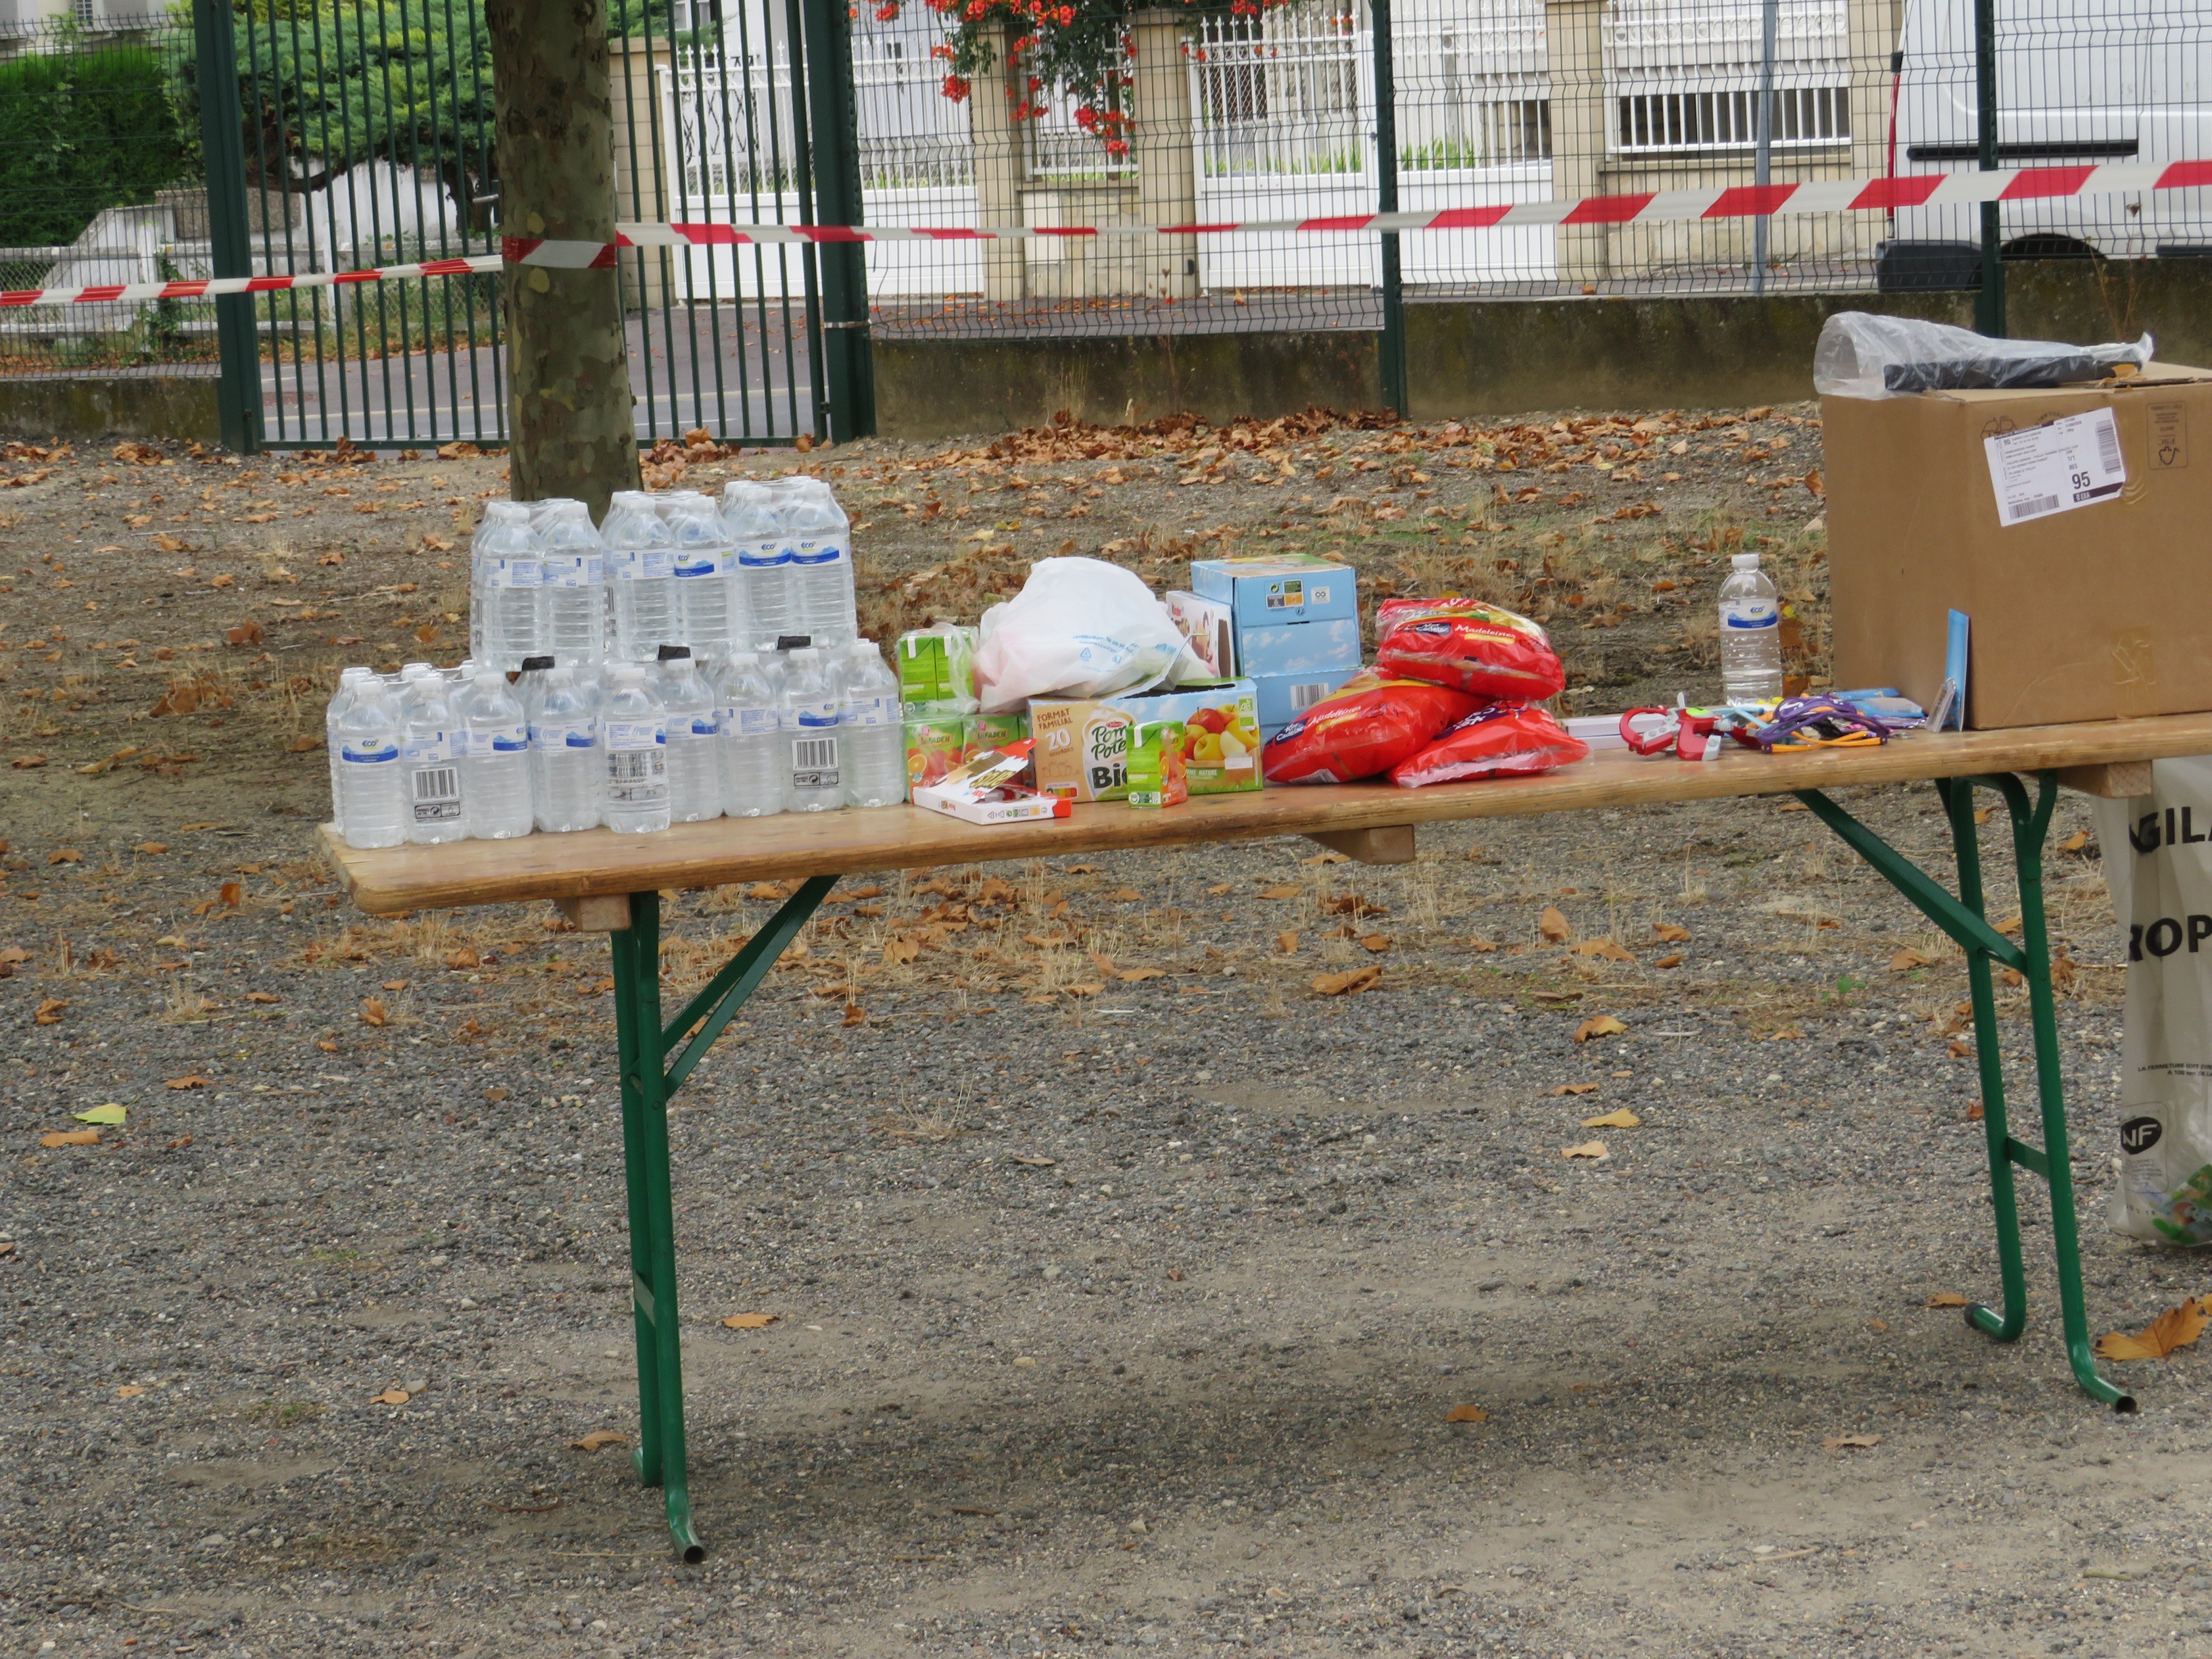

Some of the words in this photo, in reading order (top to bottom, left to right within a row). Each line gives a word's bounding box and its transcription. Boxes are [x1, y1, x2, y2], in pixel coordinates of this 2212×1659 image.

[2072, 471, 2091, 490] 95
[1455, 624, 1516, 639] Madeleines
[1037, 708, 1070, 723] FORMAT
[1039, 716, 1073, 730] FAMILIAL
[1046, 728, 1071, 751] 20
[1091, 738, 1127, 760] Pote
[2123, 1124, 2158, 1147] NF
